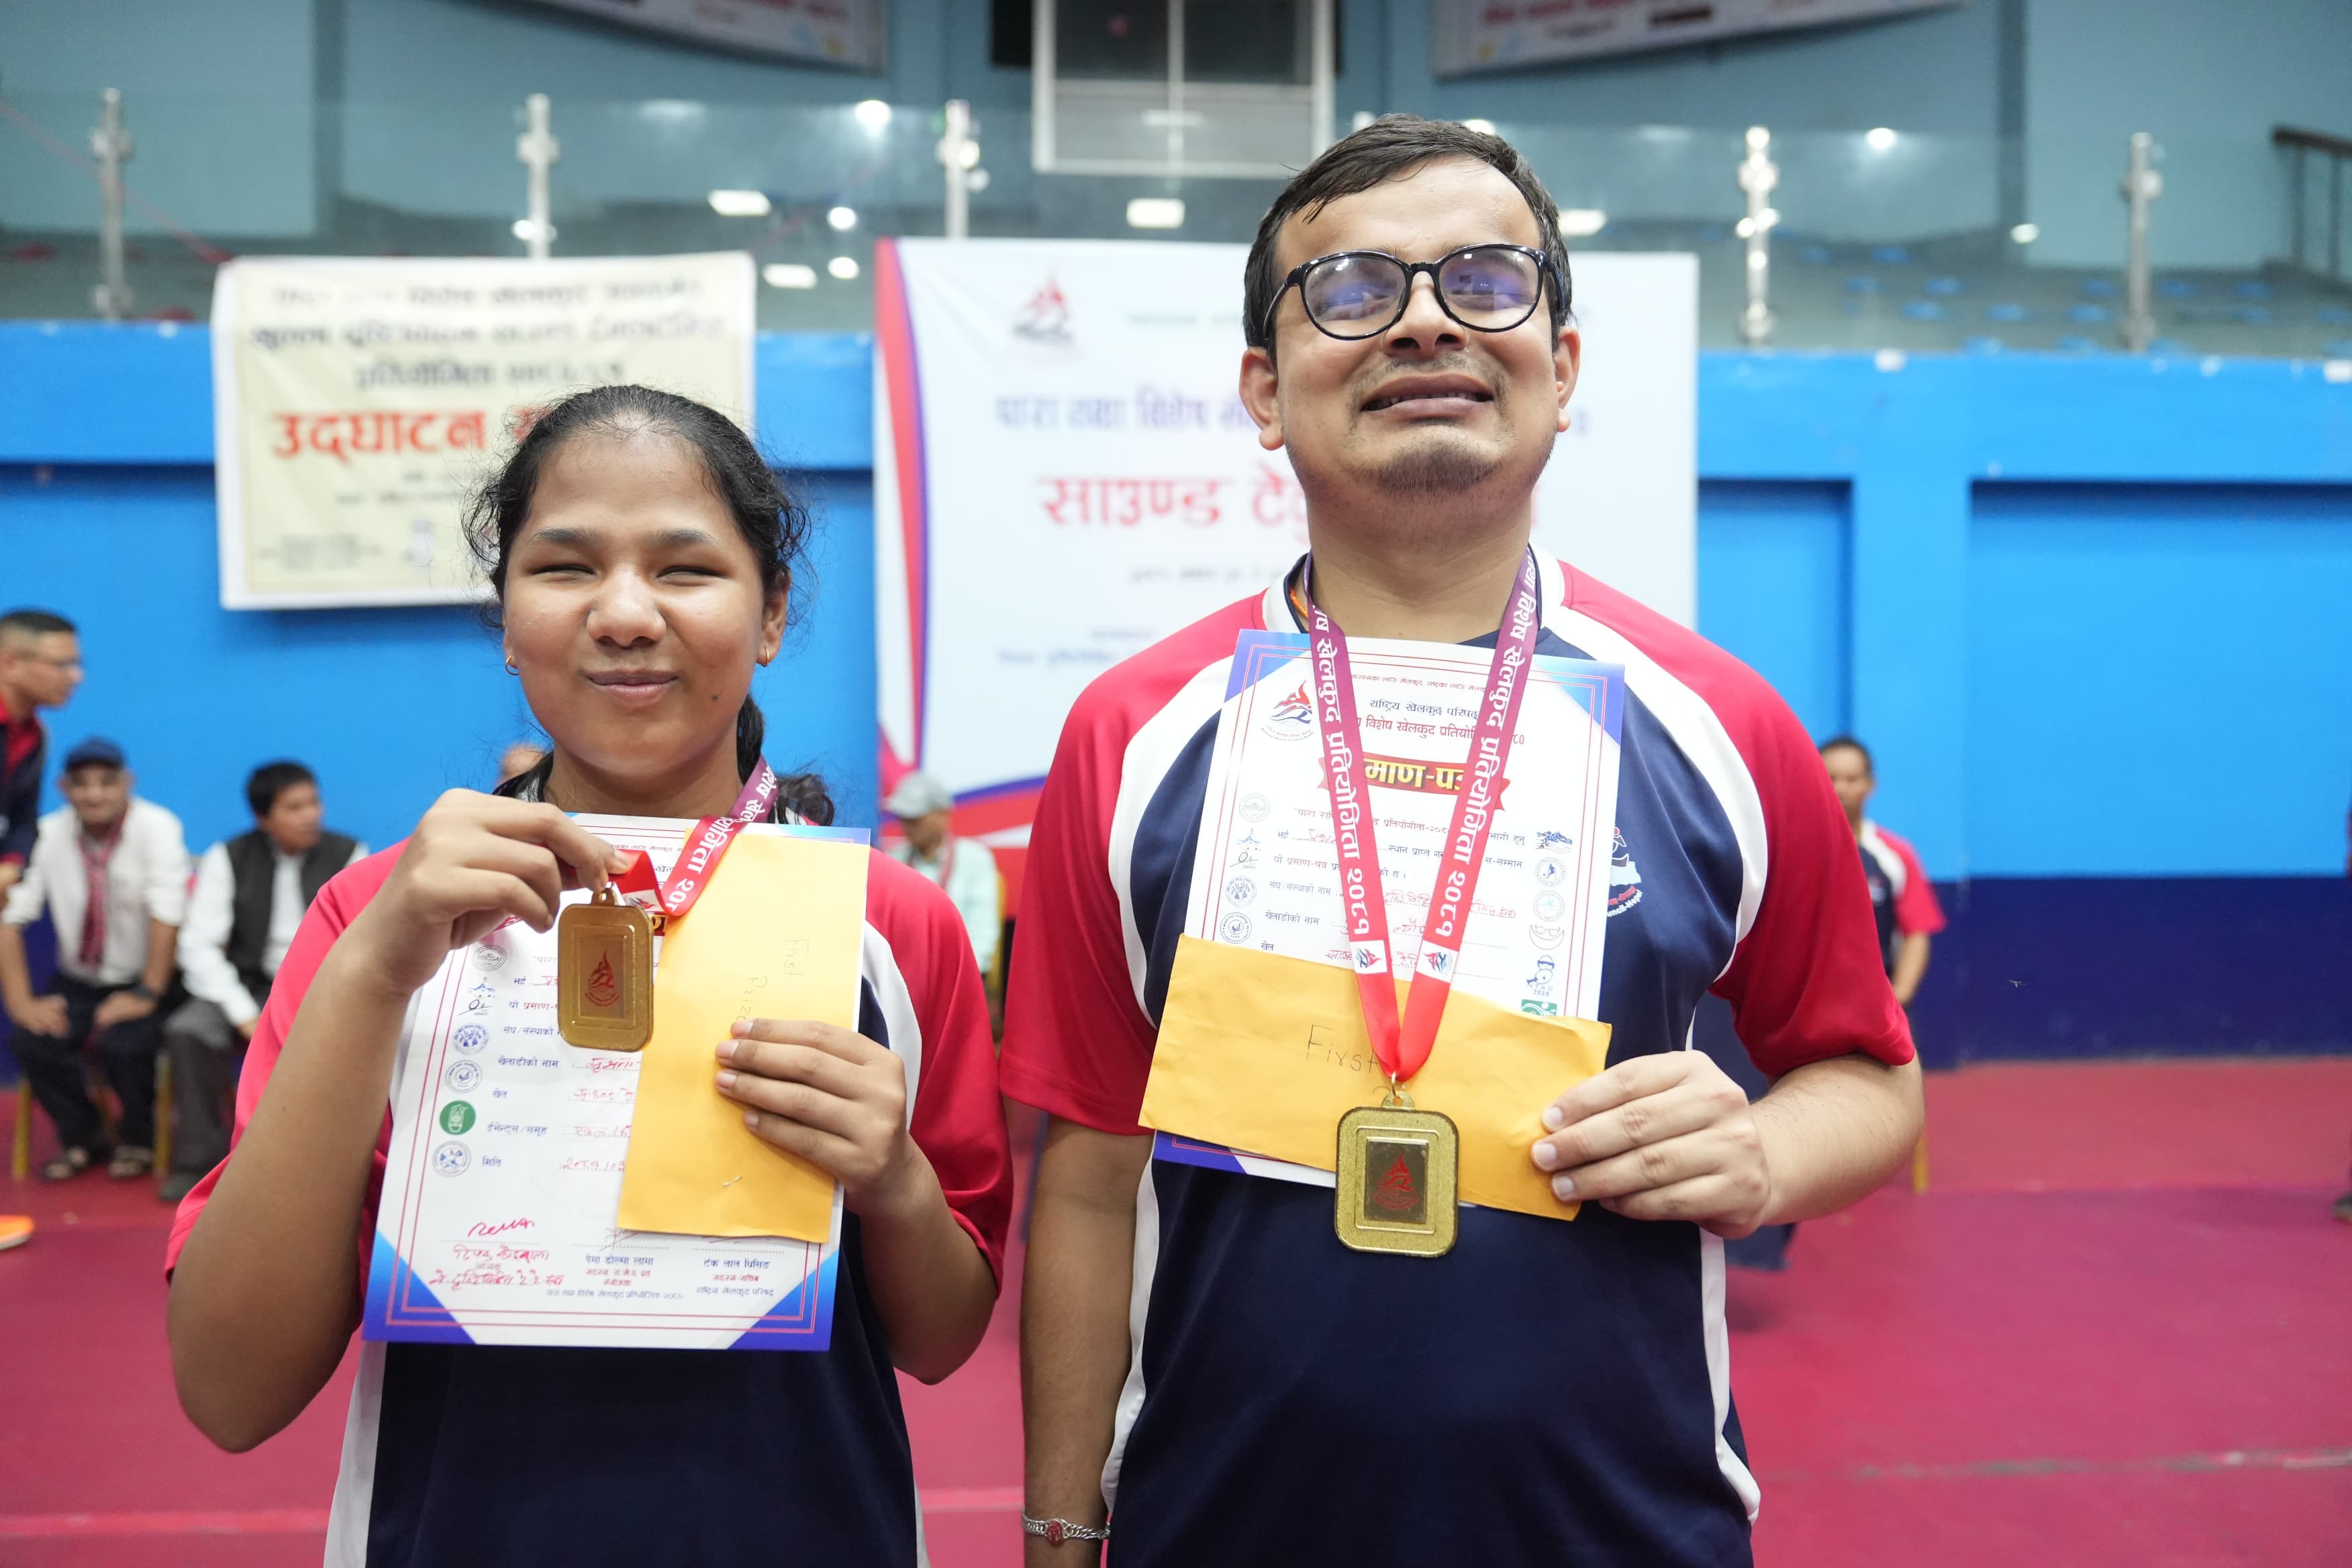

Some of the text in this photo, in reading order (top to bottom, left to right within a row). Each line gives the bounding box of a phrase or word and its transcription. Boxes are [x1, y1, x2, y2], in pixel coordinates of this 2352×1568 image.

[1510, 591, 1537, 642] विशेष
[1316, 638, 1342, 724] खेलकुद
[1486, 646, 1525, 731] खेलकुद
[1369, 699, 1401, 712] राष्ट्रिय
[1406, 701, 1443, 717] खेलकुद
[1366, 714, 1393, 730] विशेष
[1397, 717, 1436, 739] खेलकुद
[1510, 734, 1526, 746] ८०
[1363, 757, 1465, 791] माण-प
[739, 799, 765, 822] खेल
[1326, 730, 1361, 860] प्रतियोगिता
[1454, 736, 1500, 866] प्रतियोगिता
[1388, 844, 1408, 854] स्थान
[1412, 847, 1430, 858] प्राप्त
[1486, 832, 1510, 842] भागी
[1287, 857, 1328, 870] प्रमाण-पत्र
[665, 878, 695, 912] २०८
[1317, 886, 1332, 895] नाम
[1347, 868, 1370, 935] २०८१
[1435, 870, 1466, 938] २०८१
[1606, 889, 1643, 918] uncil-Nepal
[1265, 909, 1320, 926] खेलाडीको नाम
[1260, 940, 1275, 951] खेल
[542, 1059, 559, 1069] नाम
[1305, 1024, 1379, 1074] First
